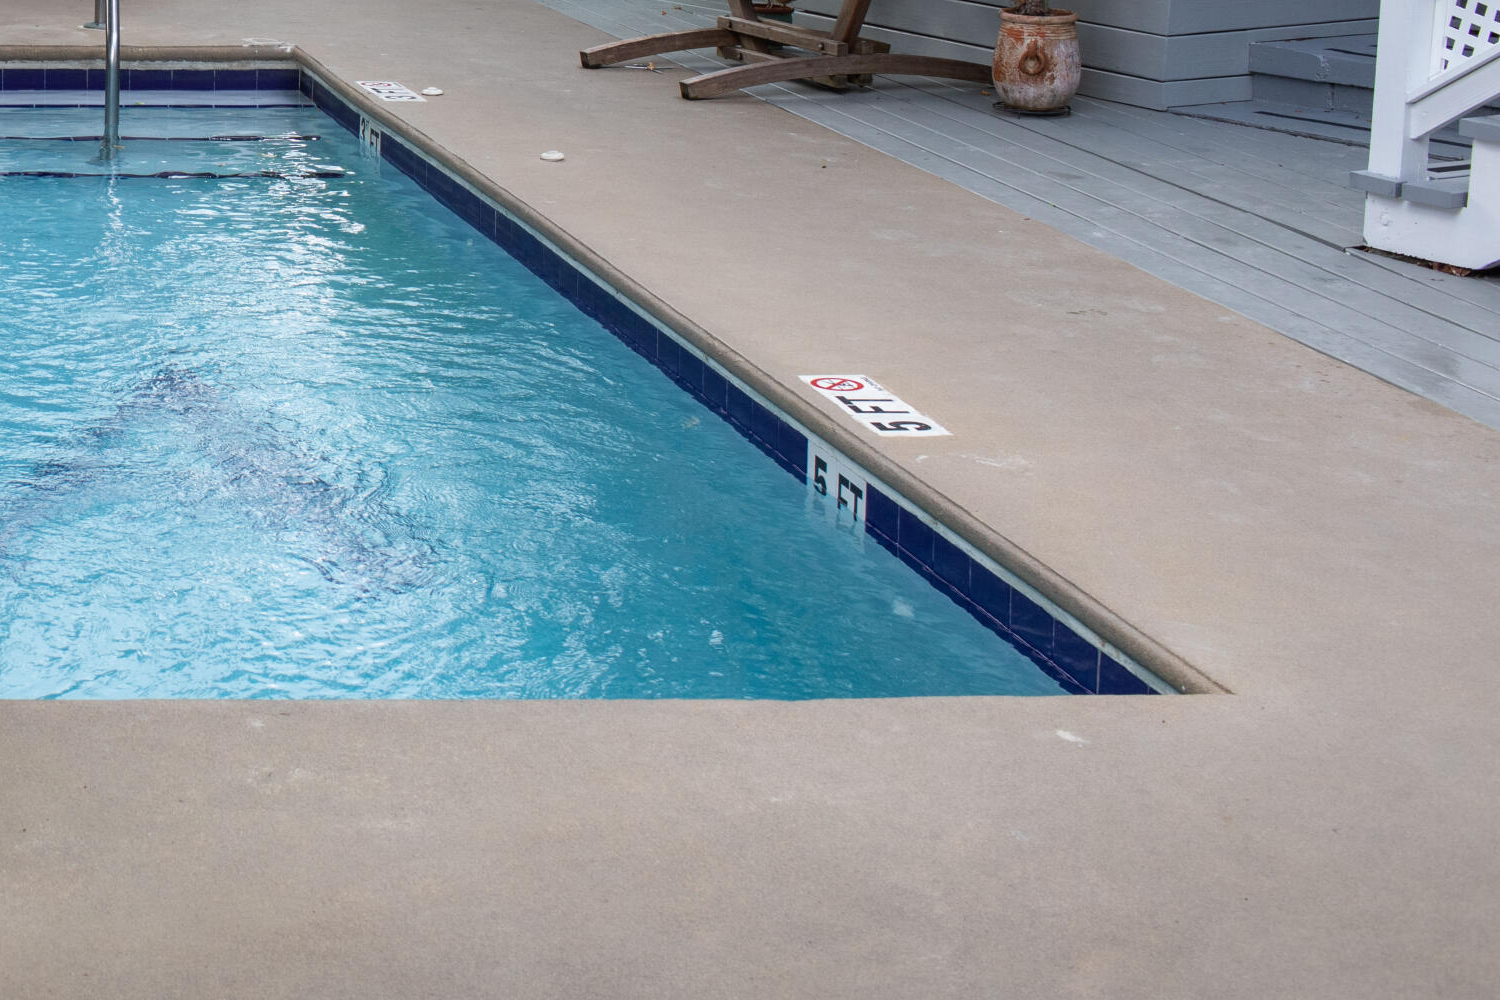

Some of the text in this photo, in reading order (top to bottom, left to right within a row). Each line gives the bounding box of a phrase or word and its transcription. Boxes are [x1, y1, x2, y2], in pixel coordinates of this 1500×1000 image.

[835, 395, 932, 432] 5 FT
[814, 455, 863, 522] 5 FT
